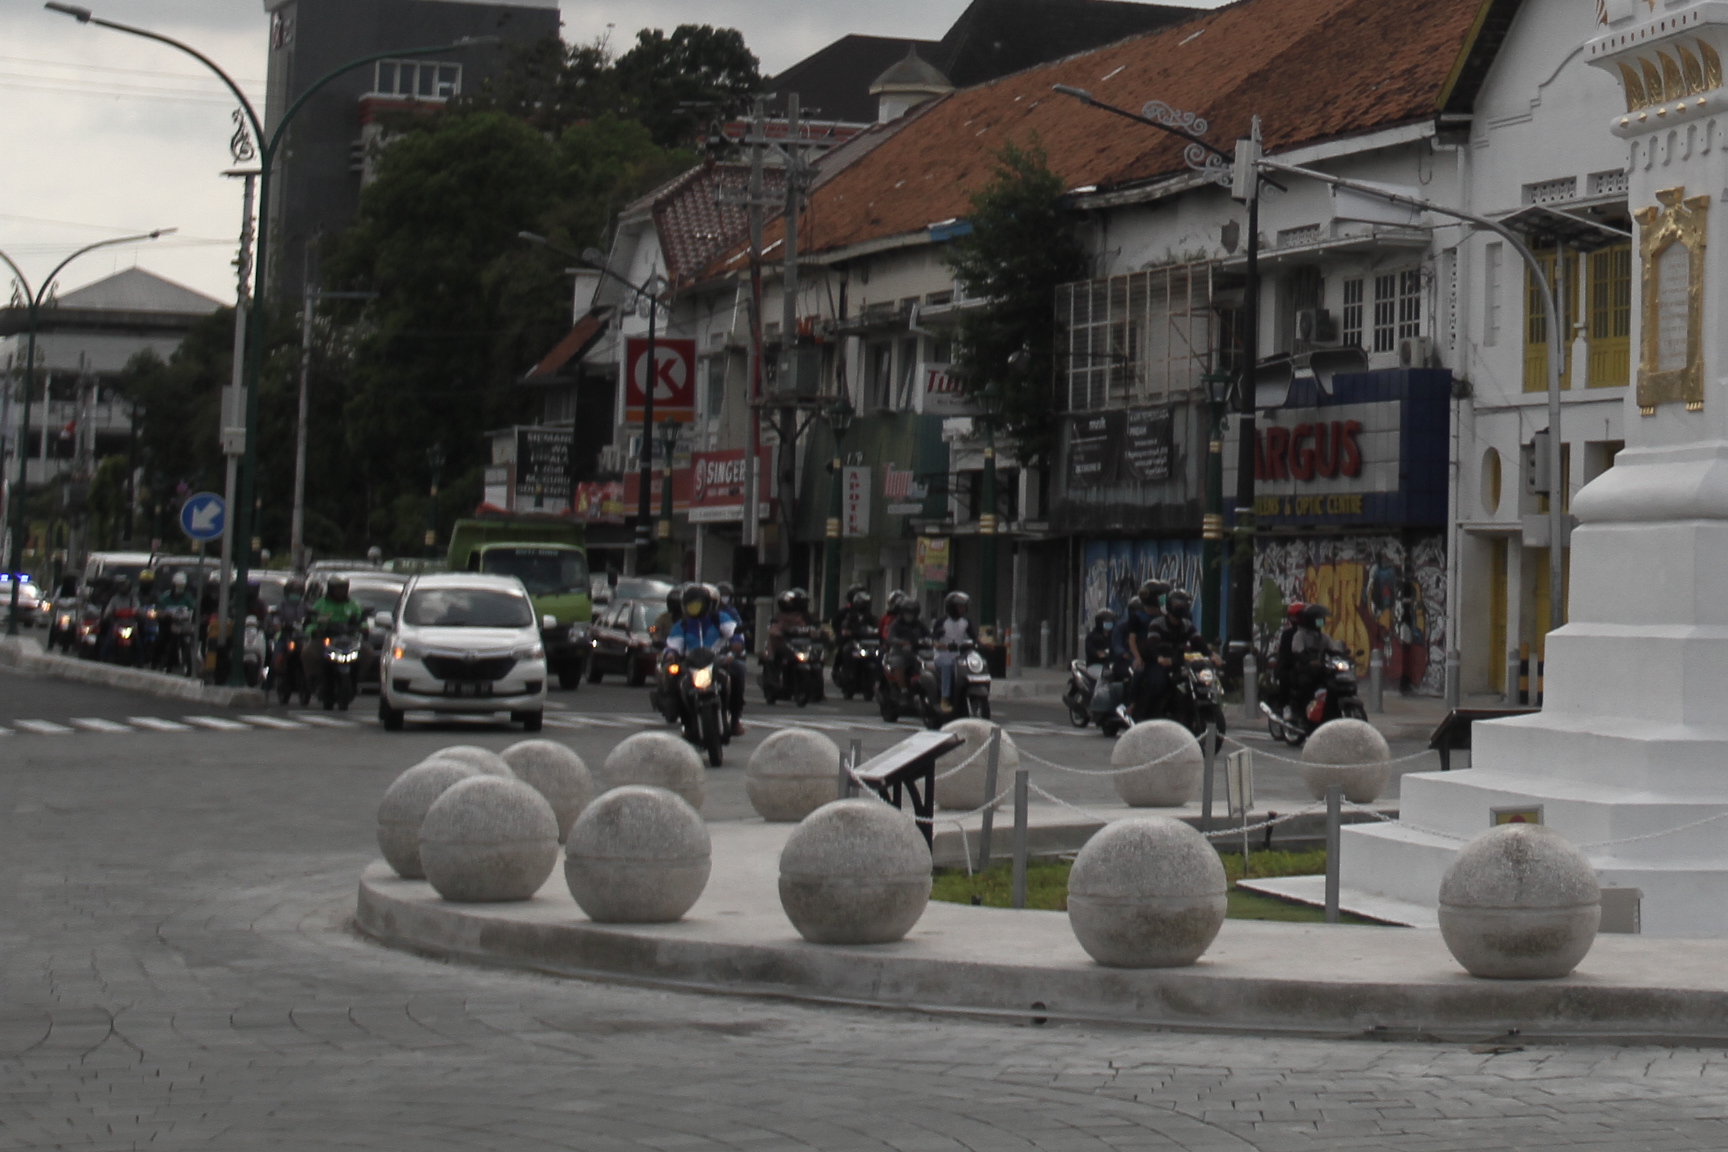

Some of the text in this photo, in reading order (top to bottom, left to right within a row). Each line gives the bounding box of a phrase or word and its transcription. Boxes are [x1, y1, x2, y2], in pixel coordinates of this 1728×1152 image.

[707, 459, 746, 485] SINGER
[1295, 496, 1324, 516] OPTIC
[1327, 494, 1362, 515] CENTRE
